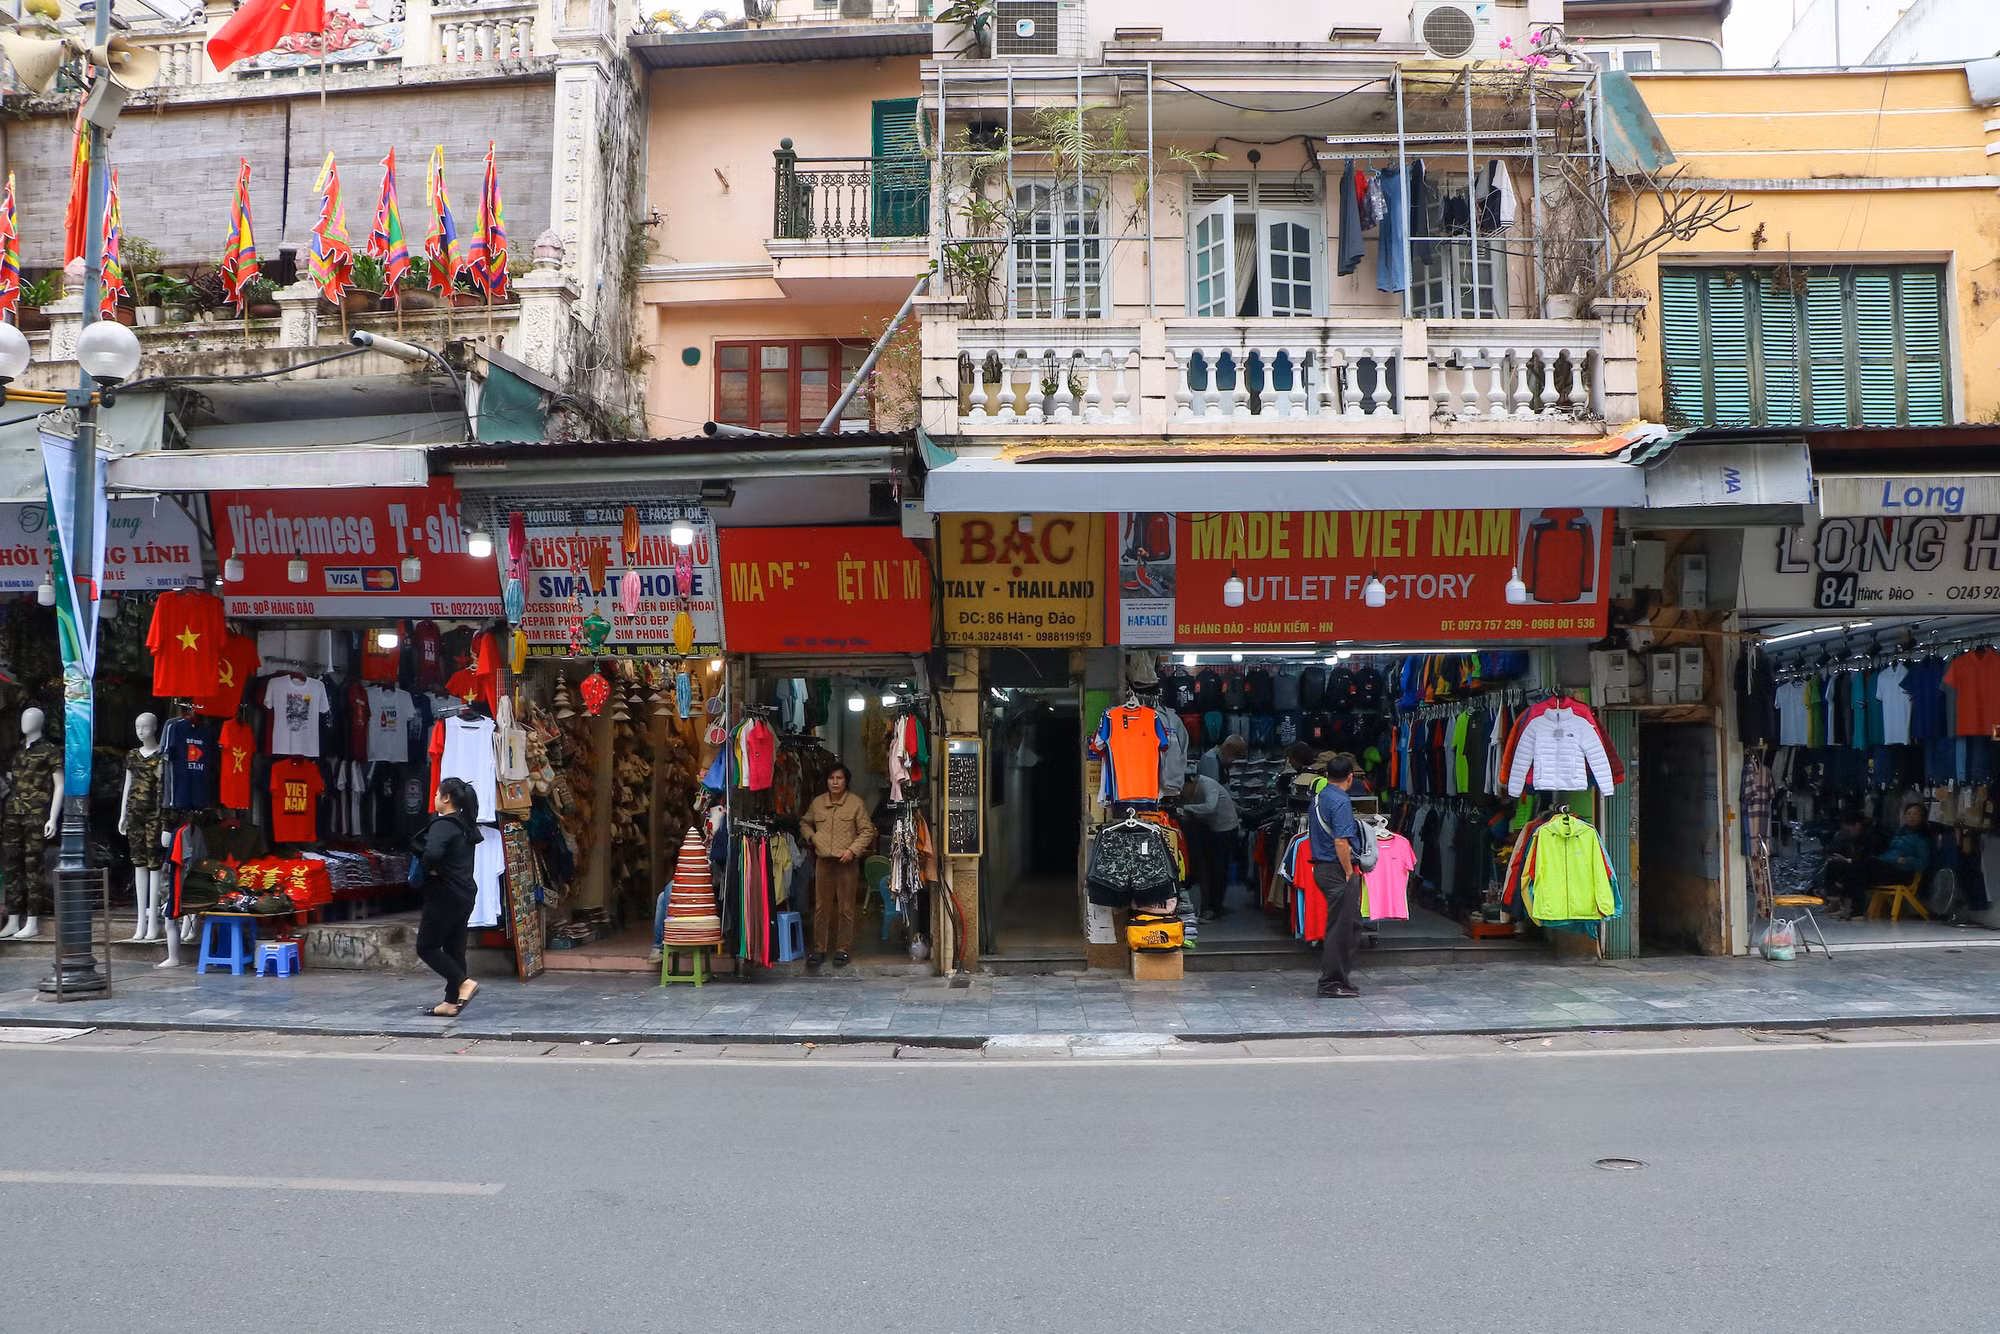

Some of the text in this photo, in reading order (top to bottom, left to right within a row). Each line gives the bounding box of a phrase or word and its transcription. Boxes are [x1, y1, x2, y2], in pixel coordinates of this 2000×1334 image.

[1882, 480, 1965, 513] Long
[107, 510, 142, 538] ung
[527, 510, 571, 523] YOUTUBE
[599, 509, 623, 522] ZALO
[227, 504, 376, 555] Vietnamese
[1191, 509, 1512, 560] MADE IN VIET NAM
[133, 541, 191, 564] LÍNH
[1777, 517, 1948, 573] LONG
[330, 573, 358, 585] VISA
[873, 559, 922, 600] NM
[942, 580, 986, 598] ITALY
[1007, 580, 1095, 599] THAILAND
[1247, 575, 1338, 602] UTLET
[1821, 576, 1855, 607] 84
[1857, 586, 1883, 601] HÀNG
[1889, 585, 1914, 601] ĐÀO
[1947, 586, 1981, 600] 0243
[1983, 586, 2000, 600] 92
[232, 602, 252, 615] ADD:
[271, 600, 296, 615] HÀNG
[297, 600, 315, 615] ĐÀO
[431, 602, 449, 615] TEL:
[521, 615, 559, 627] REPAIR
[650, 615, 669, 628] ĐẸP
[959, 612, 985, 625] ĐC:
[988, 612, 1004, 625] 86
[1007, 611, 1043, 628] Hàng
[1178, 624, 1191, 635] 86
[1193, 621, 1221, 635] HÀNG
[1223, 620, 1244, 635] ĐÀO
[1253, 621, 1281, 634] HOÀN
[1319, 622, 1334, 633] HN
[1441, 620, 1456, 631] ĐT:
[1458, 620, 1482, 631] 0973
[1485, 620, 1502, 630] 757
[1504, 620, 1523, 630] 299
[1531, 619, 1555, 630] 0968
[1557, 619, 1575, 630] 001
[1577, 618, 1595, 629] 536
[544, 629, 567, 640] FREE
[615, 629, 633, 640] SIM
[636, 628, 669, 640] PHONG
[285, 782, 308, 796] VIET
